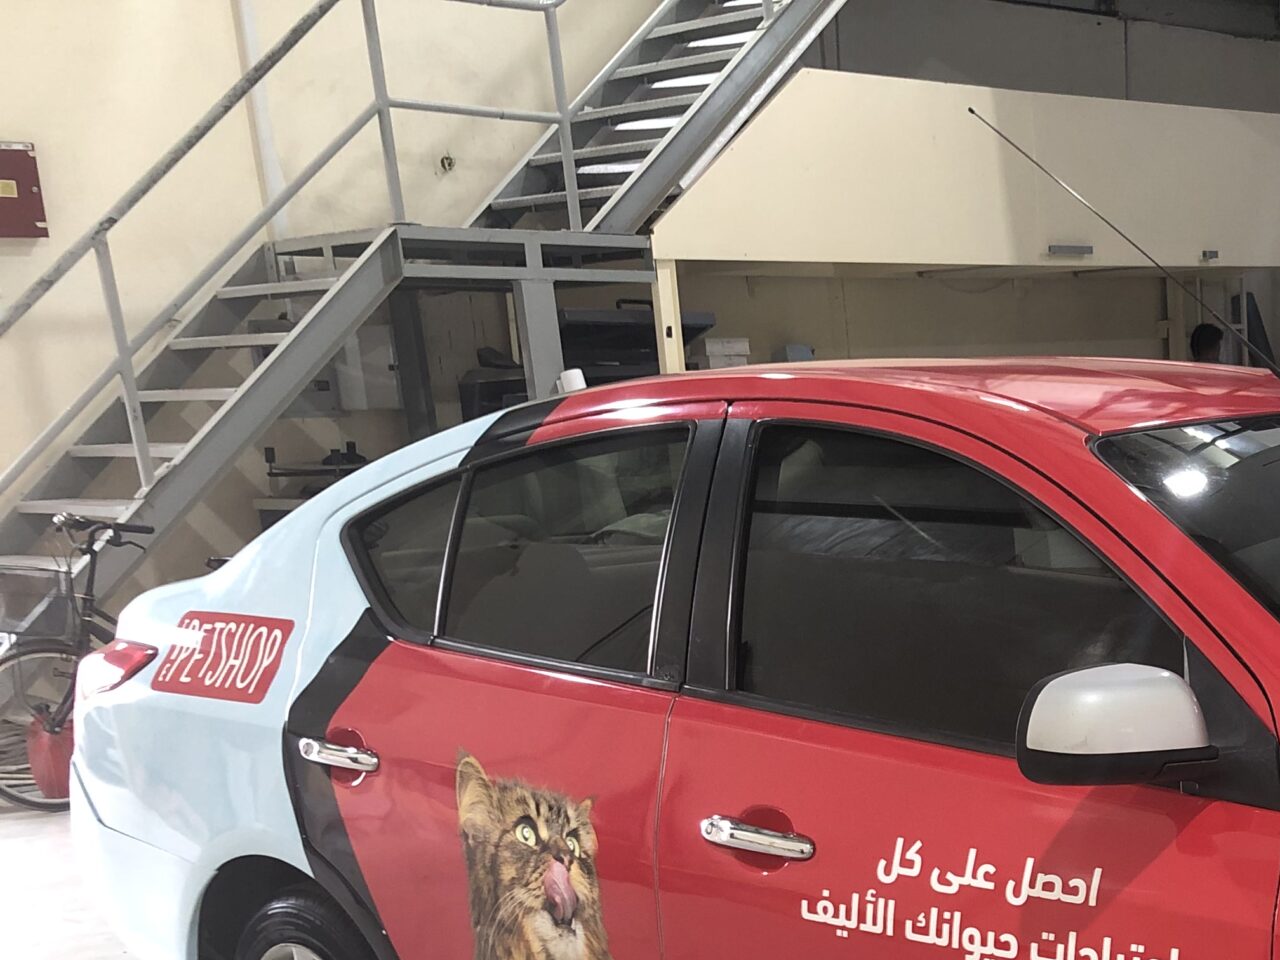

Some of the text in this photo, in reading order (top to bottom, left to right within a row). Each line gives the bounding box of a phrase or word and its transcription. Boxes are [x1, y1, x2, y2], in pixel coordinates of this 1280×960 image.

[164, 617, 283, 694] PETSHOP
[876, 836, 923, 884] كل
[1005, 857, 1103, 907] احصل
[800, 888, 896, 938] الأليف
